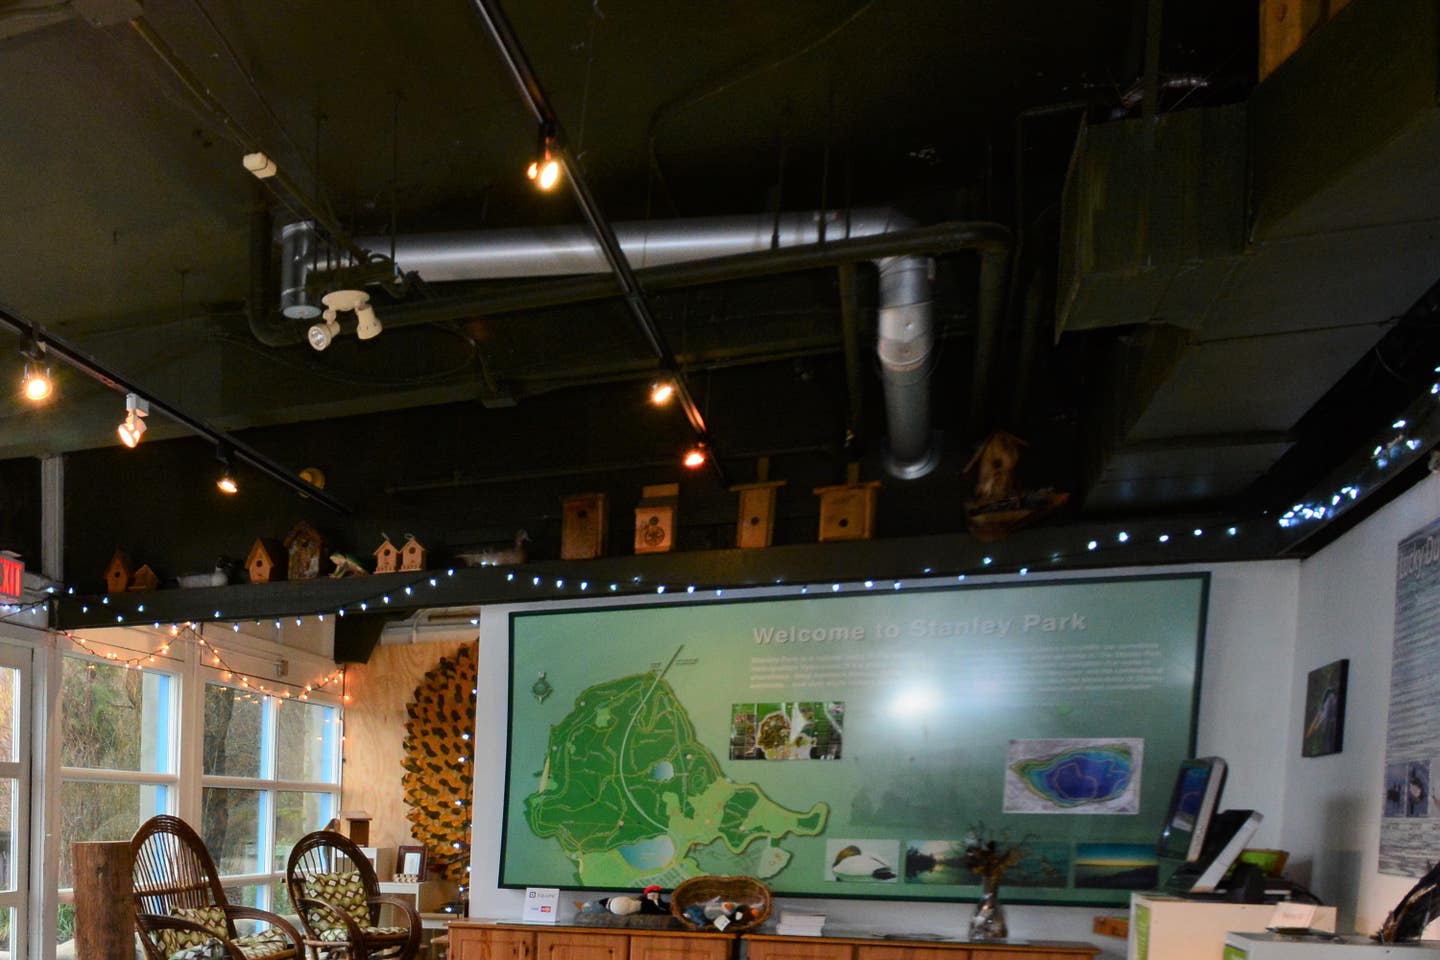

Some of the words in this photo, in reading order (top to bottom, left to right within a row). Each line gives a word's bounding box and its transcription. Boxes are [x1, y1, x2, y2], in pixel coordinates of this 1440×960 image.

[753, 625, 865, 645] Welcome
[875, 623, 900, 640] to
[911, 616, 1011, 638] Stanley
[1023, 613, 1089, 633] Park
